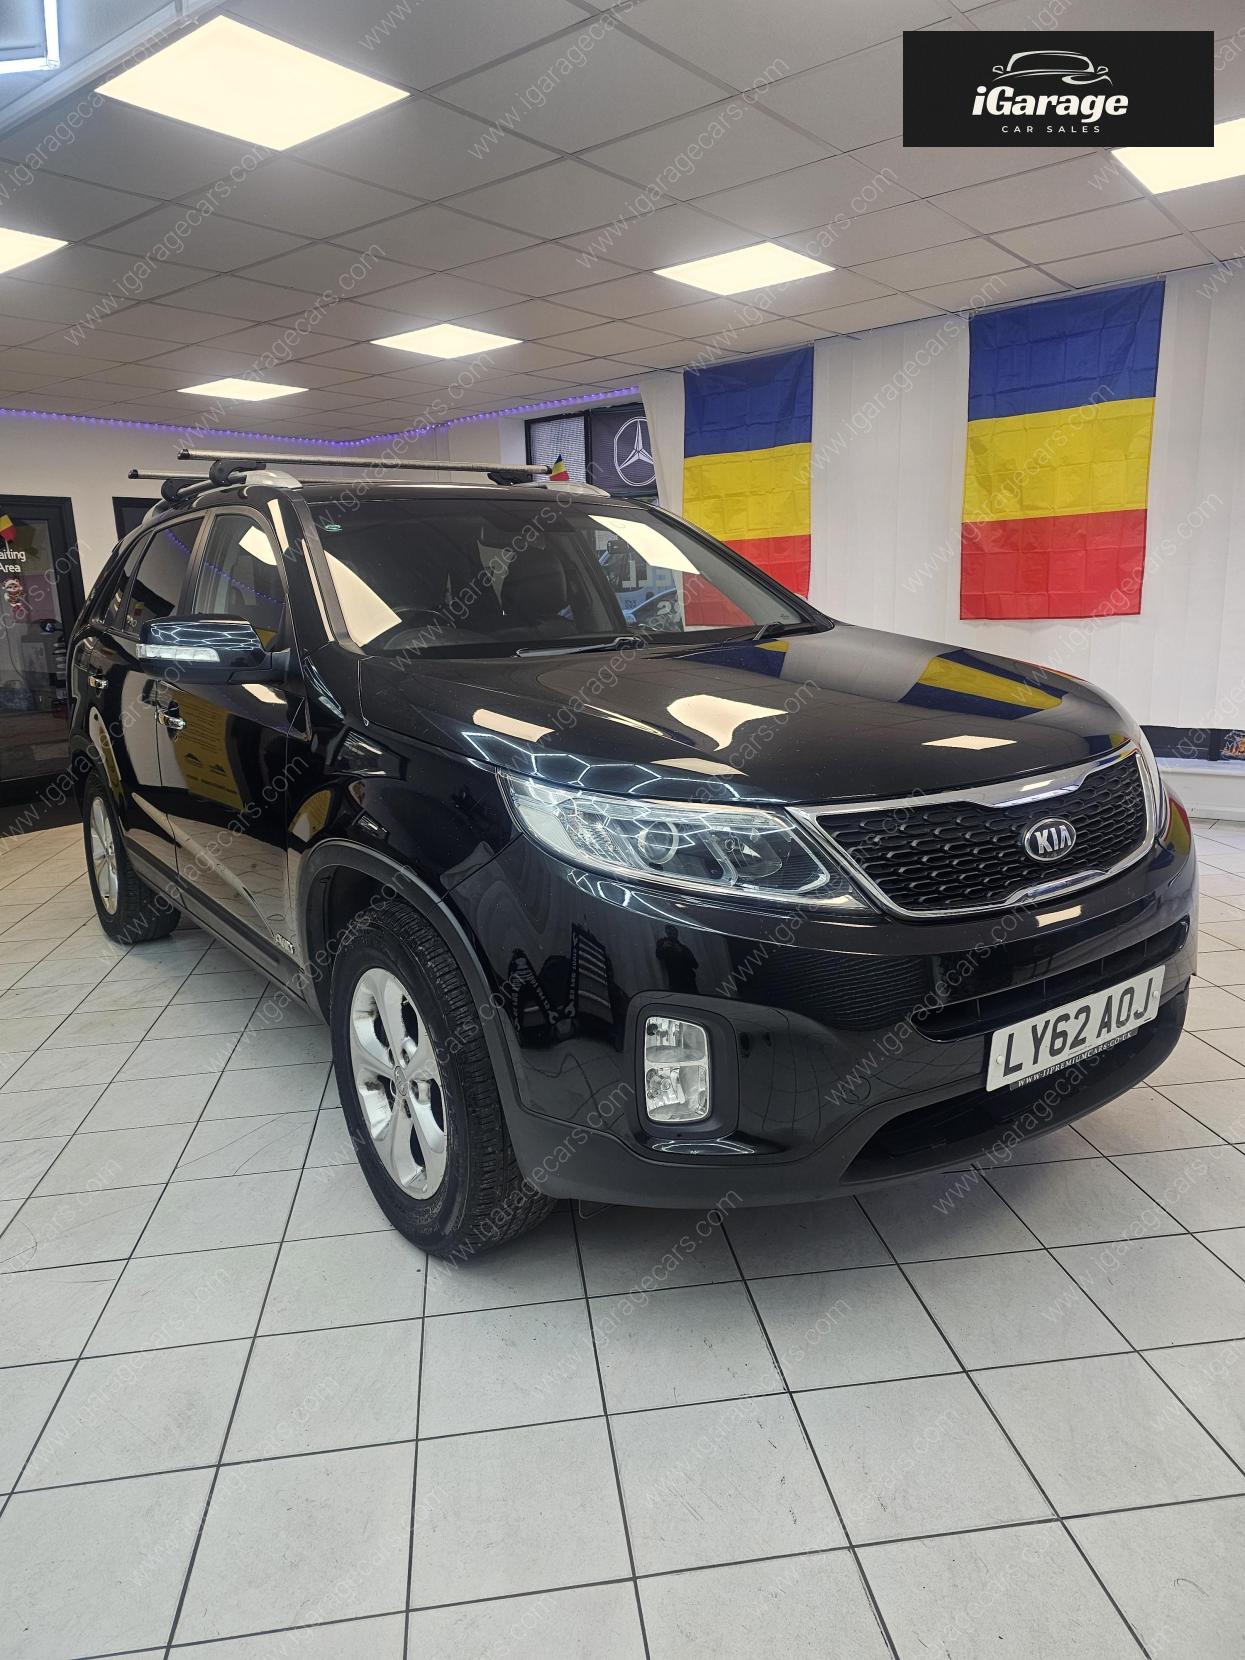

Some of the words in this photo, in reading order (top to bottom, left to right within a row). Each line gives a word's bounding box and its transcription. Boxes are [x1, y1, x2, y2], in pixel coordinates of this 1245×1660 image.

[1034, 825, 1072, 854] KIA
[1003, 1005, 1091, 1078] LY62
[1096, 977, 1154, 1039] AOJ
